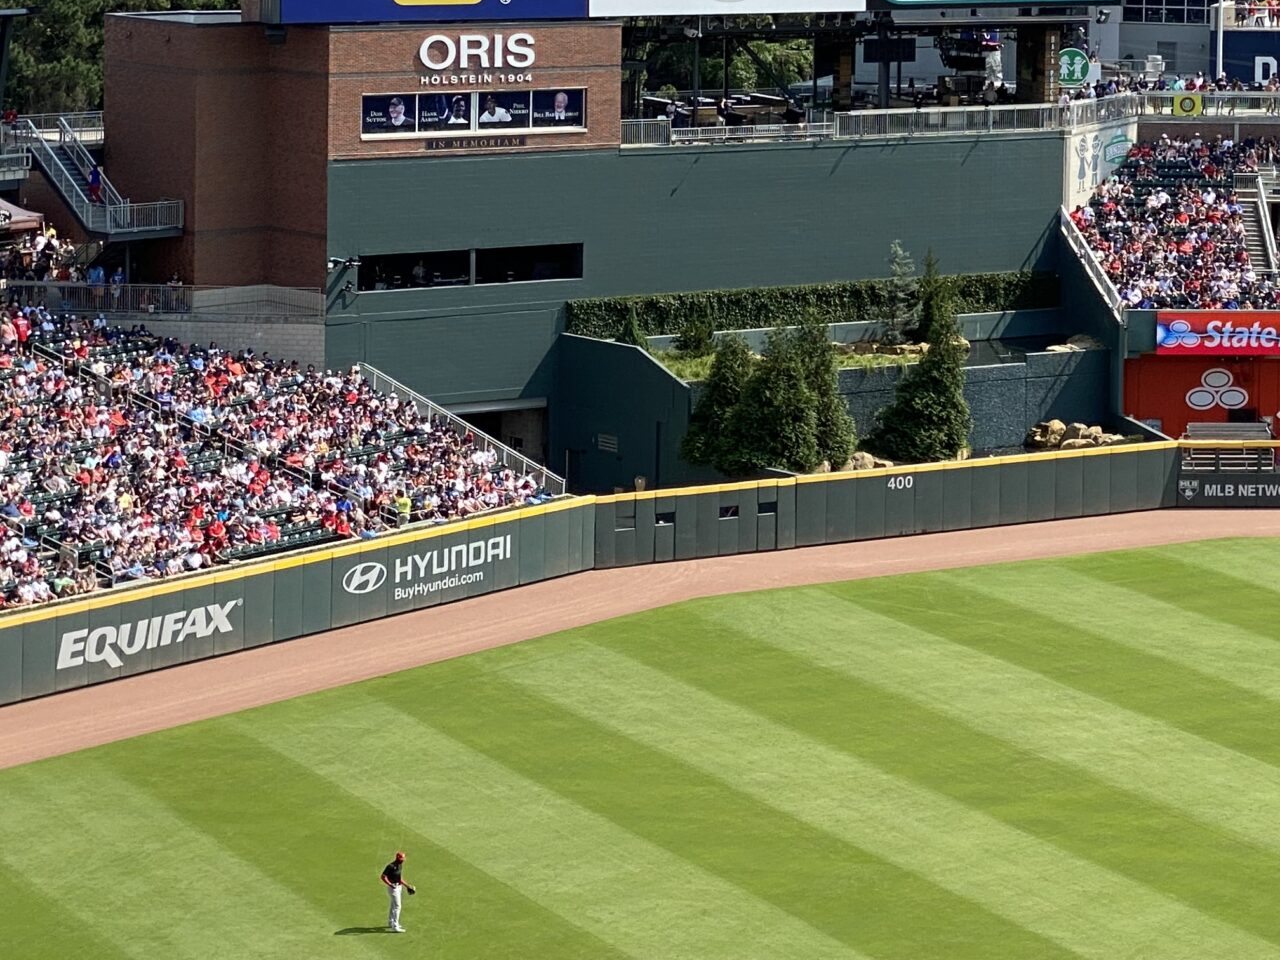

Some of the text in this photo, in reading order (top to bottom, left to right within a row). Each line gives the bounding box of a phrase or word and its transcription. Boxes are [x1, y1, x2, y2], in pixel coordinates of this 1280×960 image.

[418, 32, 536, 70] ORIS
[420, 73, 533, 85] HÖLSTEIN 1904
[452, 138, 521, 148] MEMORIAM
[887, 476, 914, 490] 400
[1204, 484, 1234, 497] MLB
[394, 534, 512, 584] HYUNDAI
[394, 571, 484, 601] BuyHyundai.com
[56, 602, 238, 669] EQUIFAX
